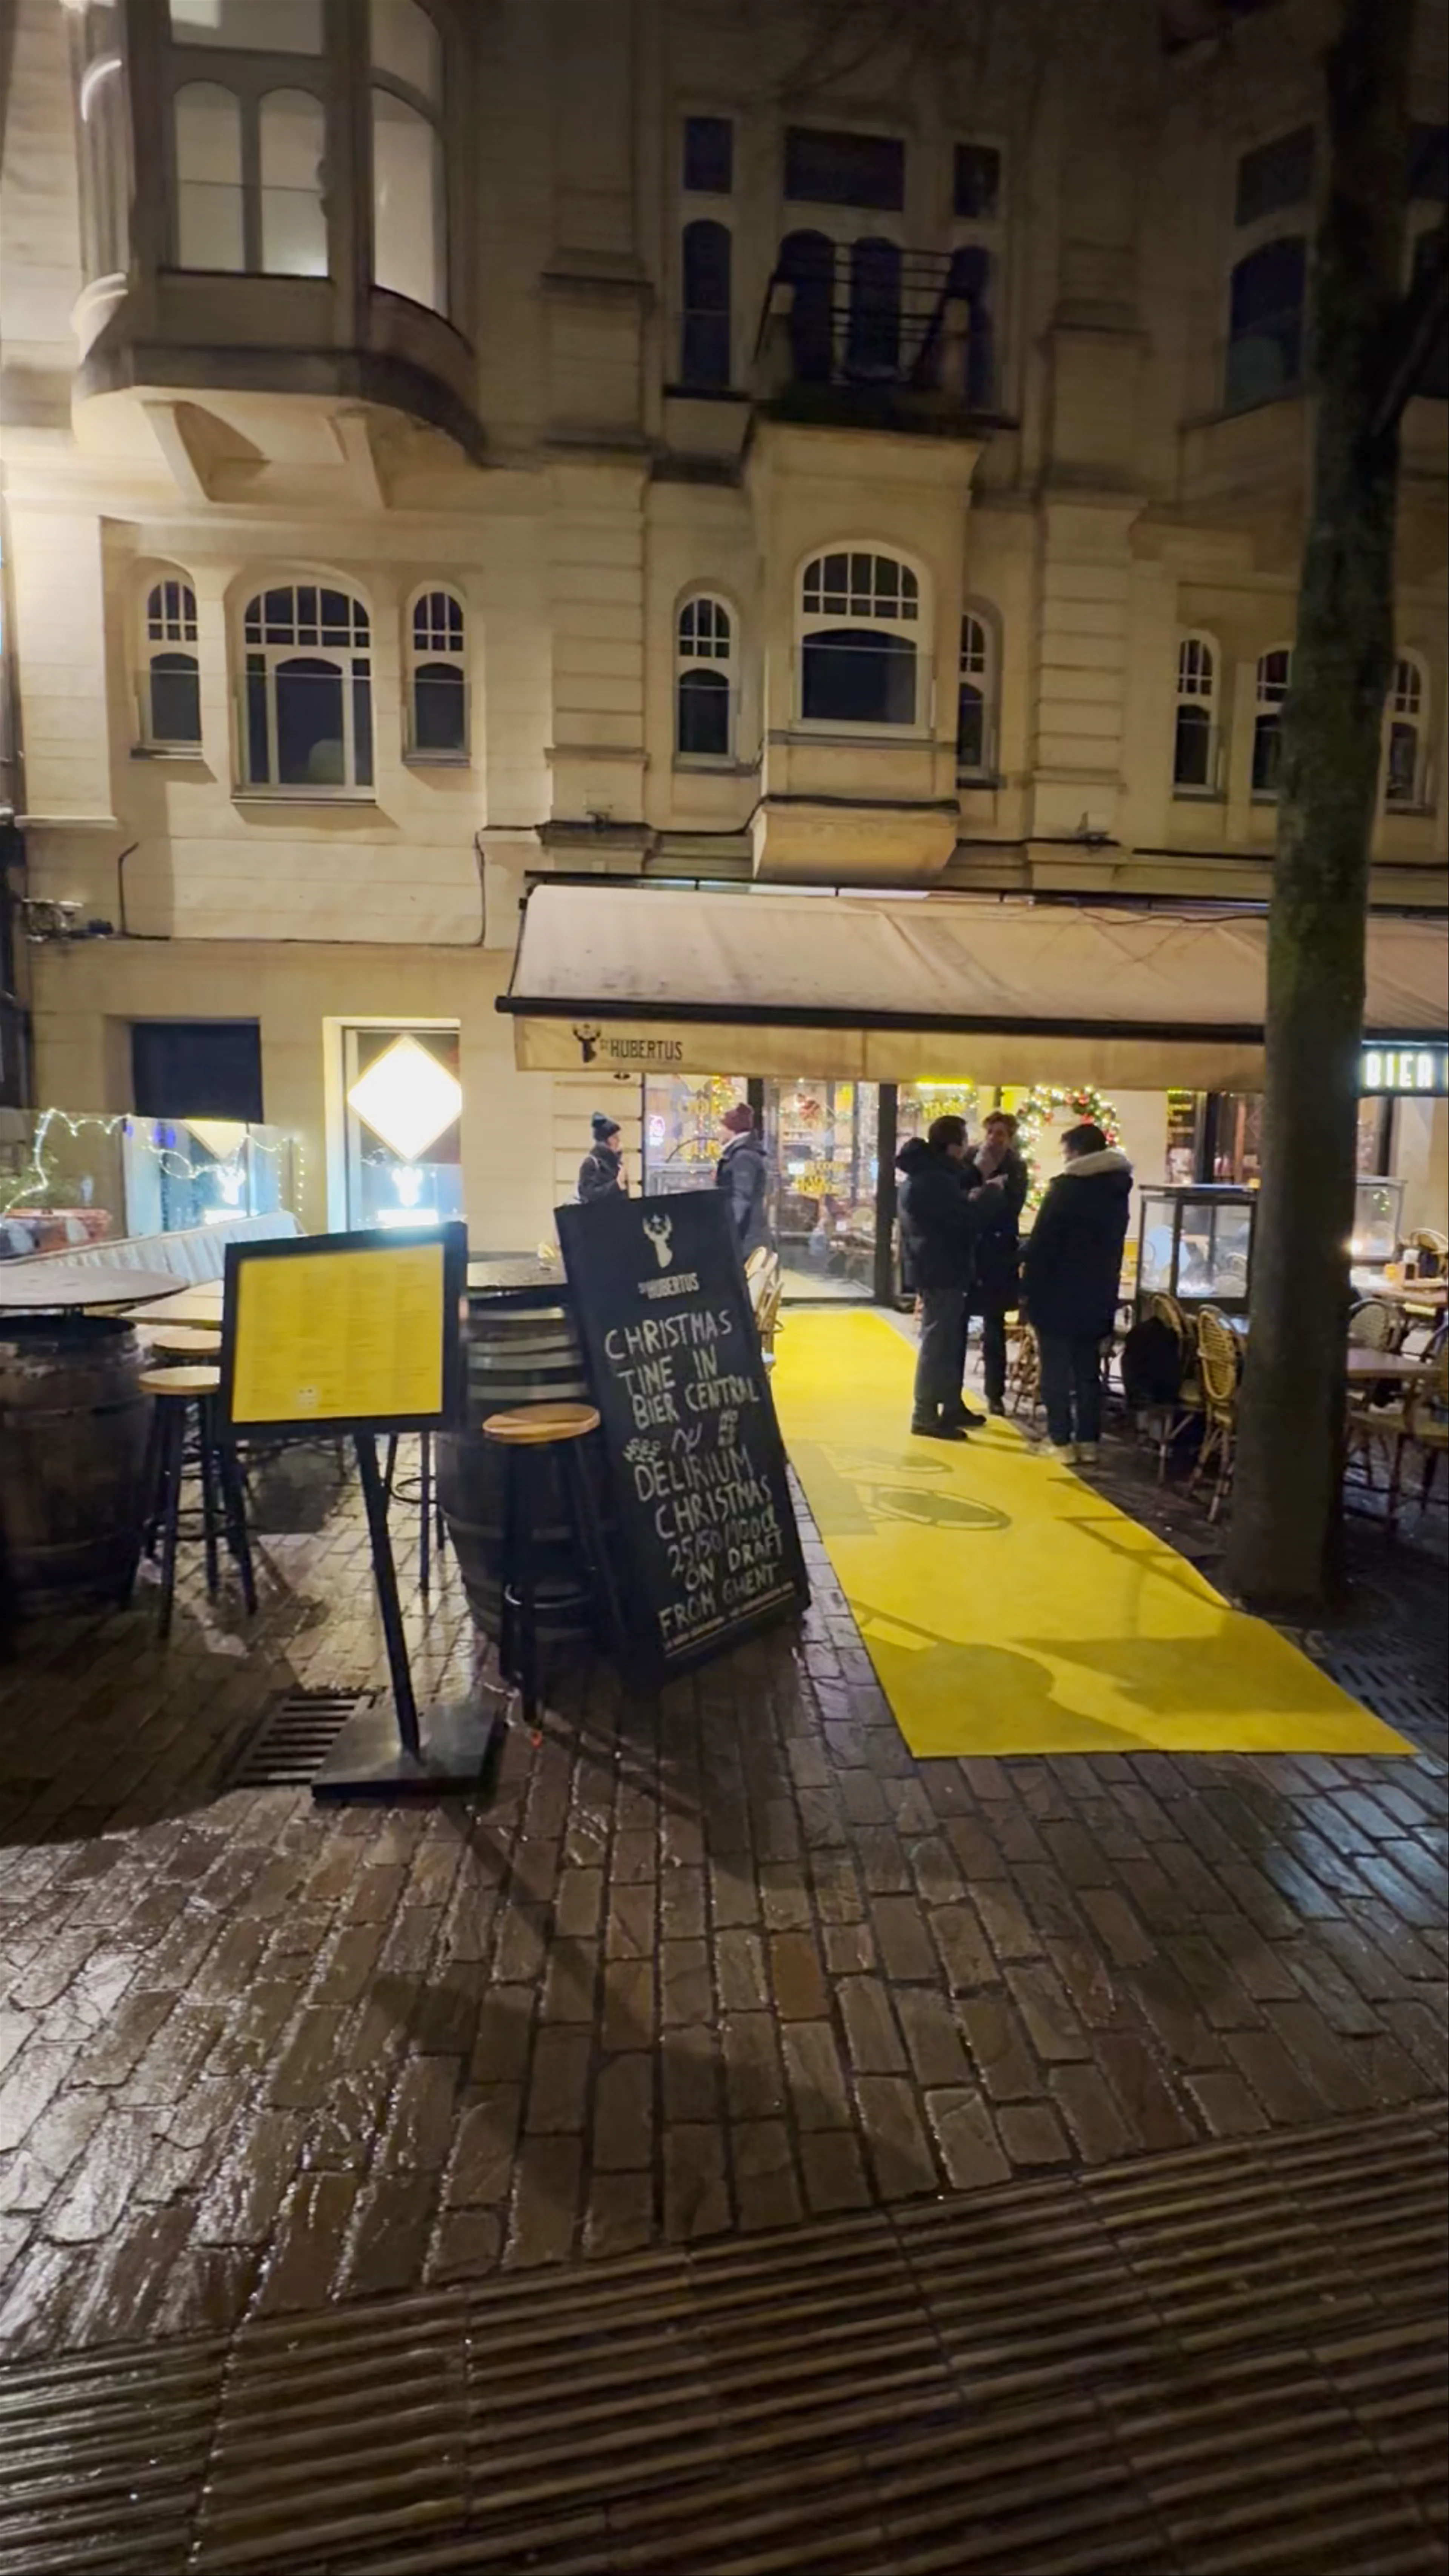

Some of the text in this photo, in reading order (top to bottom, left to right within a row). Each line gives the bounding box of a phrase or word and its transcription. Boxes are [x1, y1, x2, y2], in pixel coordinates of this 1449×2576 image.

[610, 1039, 683, 1060] HUBERTUS
[1364, 1052, 1432, 1088] BIER
[605, 1309, 732, 1360] CHRISTMAS
[693, 1343, 717, 1380] IN
[632, 1374, 760, 1430] BIER CENTRAL
[634, 1444, 753, 1503] DELIRIUM
[655, 1474, 772, 1539] CHRISTMAS
[685, 1529, 783, 1592] ON DRAFT
[658, 1561, 779, 1639] FROM GHENT
